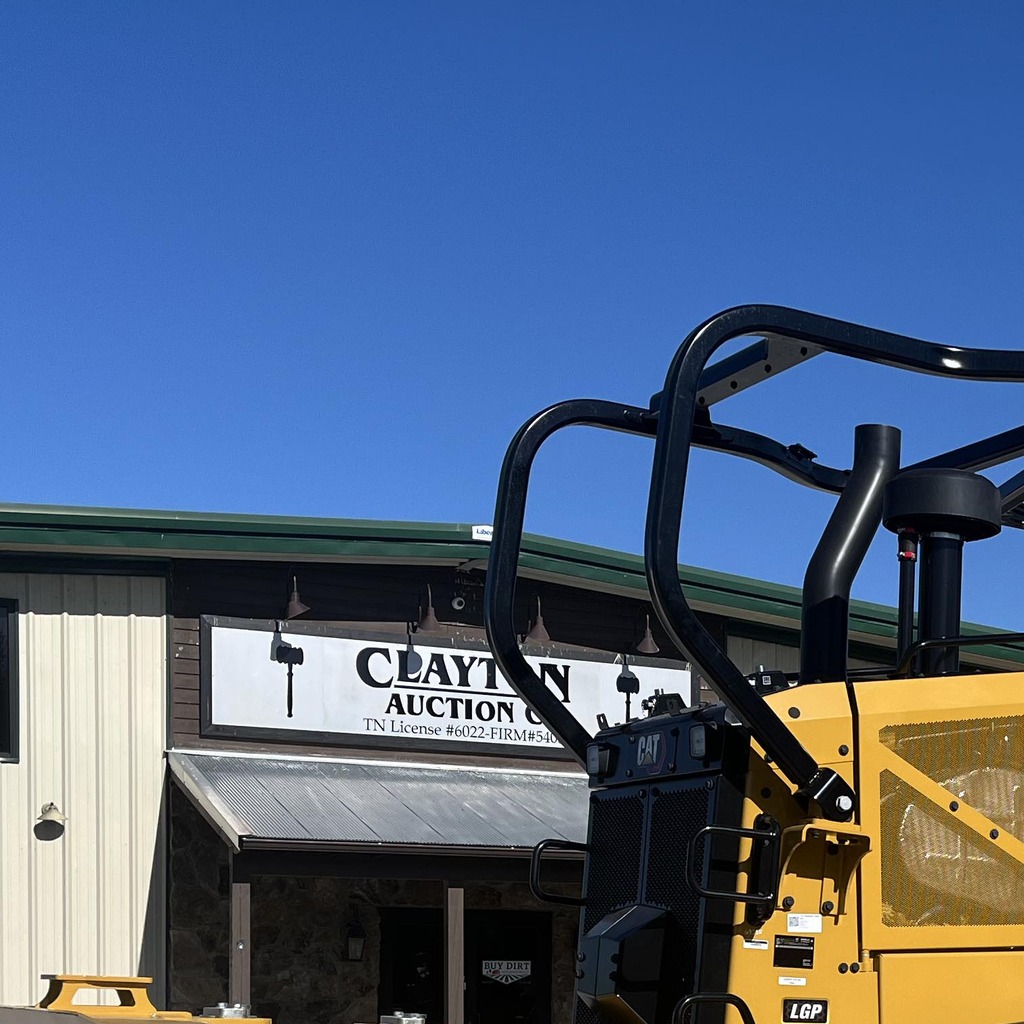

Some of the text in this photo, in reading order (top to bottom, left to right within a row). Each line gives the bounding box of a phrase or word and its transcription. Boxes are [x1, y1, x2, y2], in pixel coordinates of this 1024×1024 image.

[356, 647, 571, 703] CLAYTN
[385, 693, 514, 723] AUCTION
[363, 718, 386, 732] TN
[391, 719, 442, 736] License
[637, 733, 661, 767] CAT
[484, 962, 530, 970] BUY DIRT
[790, 1003, 823, 1020] LGP
